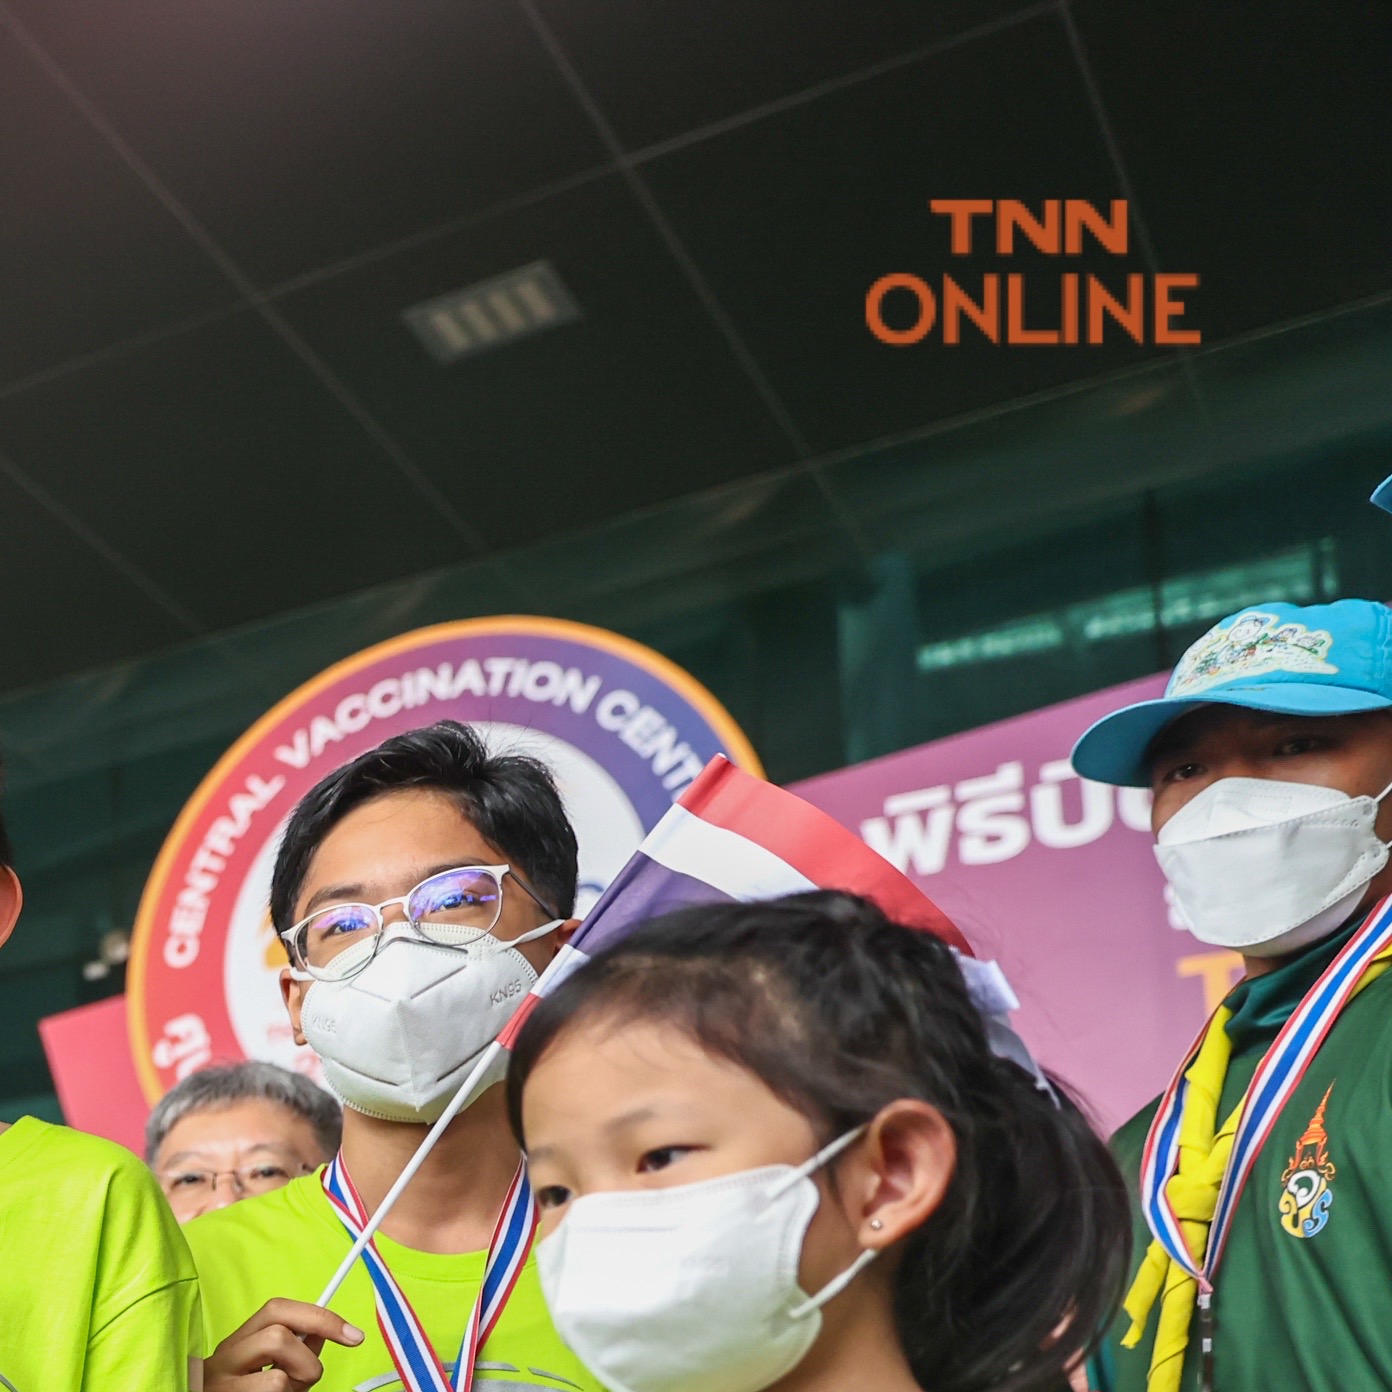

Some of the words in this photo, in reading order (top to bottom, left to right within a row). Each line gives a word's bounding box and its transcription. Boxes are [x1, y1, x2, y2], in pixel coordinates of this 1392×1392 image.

[163, 773, 286, 969] CENTRAL
[274, 656, 603, 769] VACCINATION
[595, 689, 705, 804] CENT
[489, 979, 523, 1006] KN95
